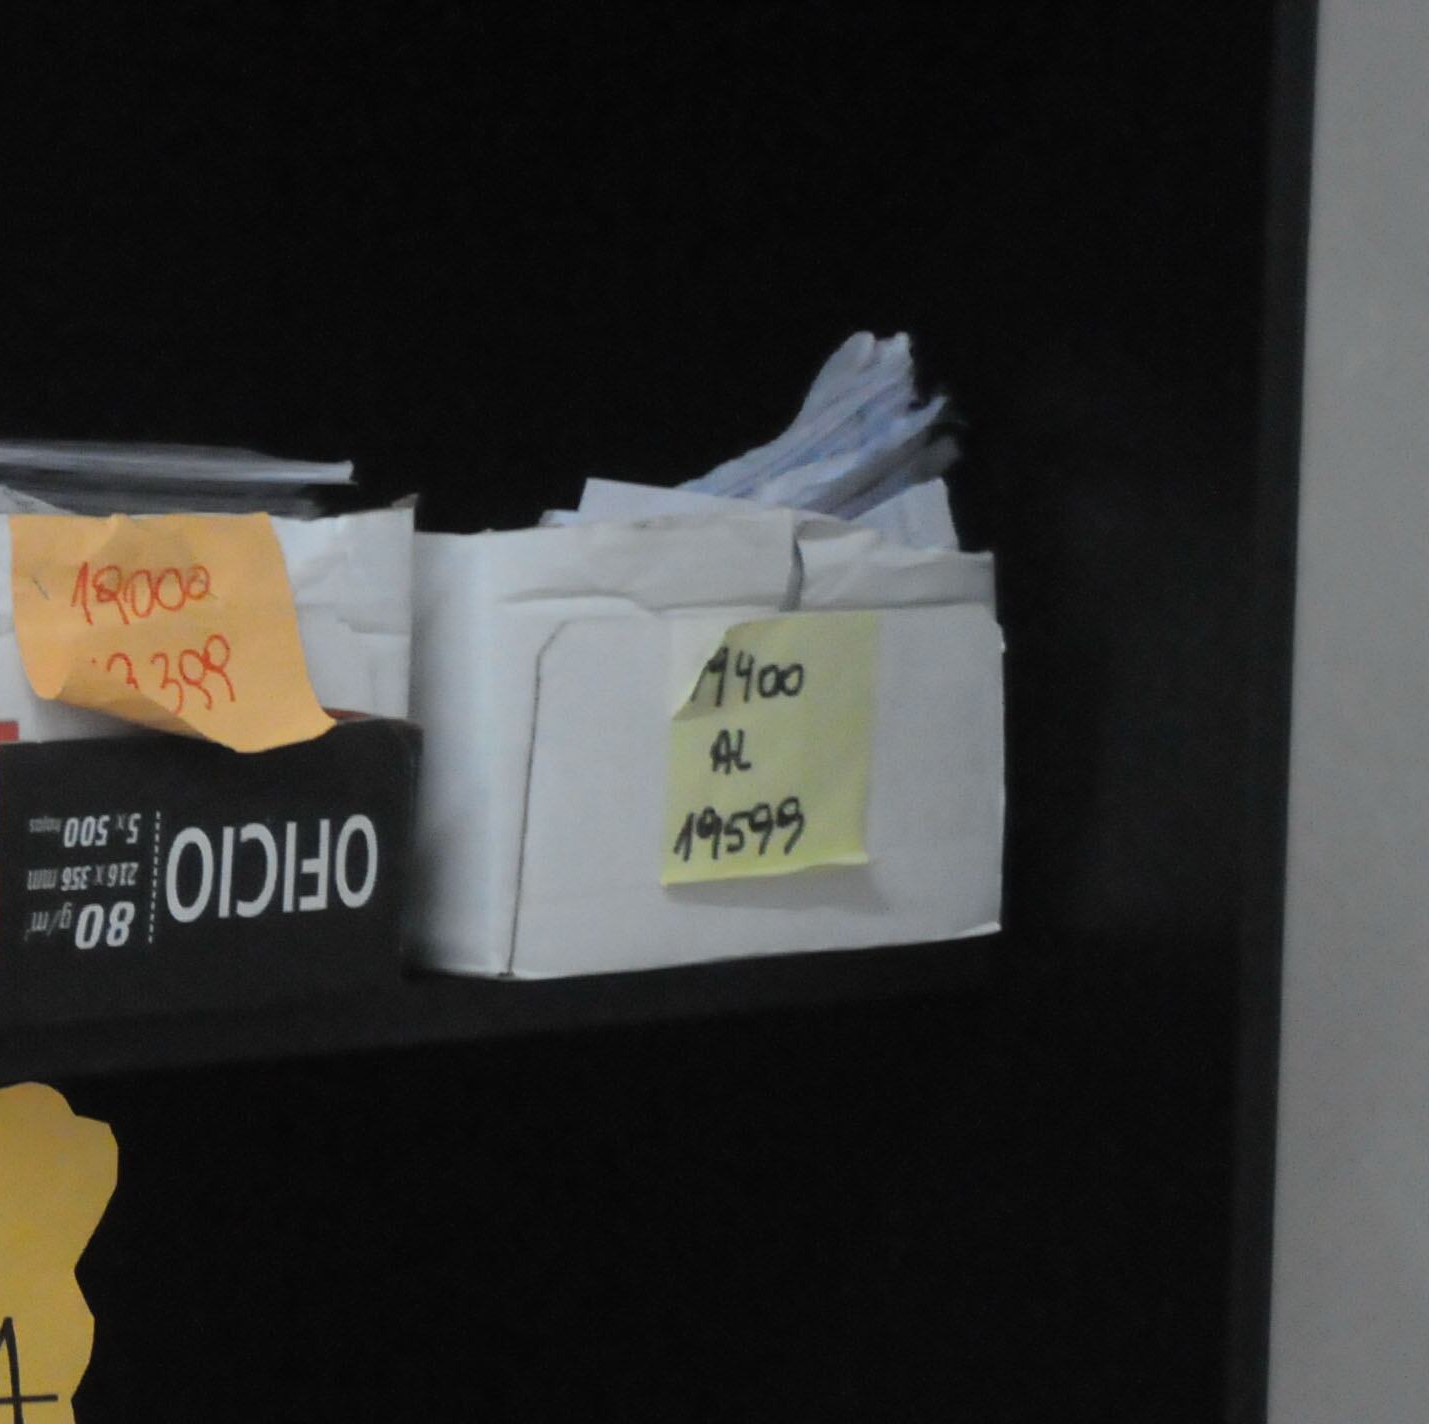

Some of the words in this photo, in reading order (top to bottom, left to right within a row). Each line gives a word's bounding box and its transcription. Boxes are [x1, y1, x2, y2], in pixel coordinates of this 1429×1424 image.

[63, 816, 109, 849] 500
[125, 813, 142, 845] 5
[673, 797, 804, 861] 19599
[61, 863, 91, 892] 356
[108, 862, 137, 888] 216
[165, 814, 378, 923] OFICIO
[74, 901, 136, 950] 80
